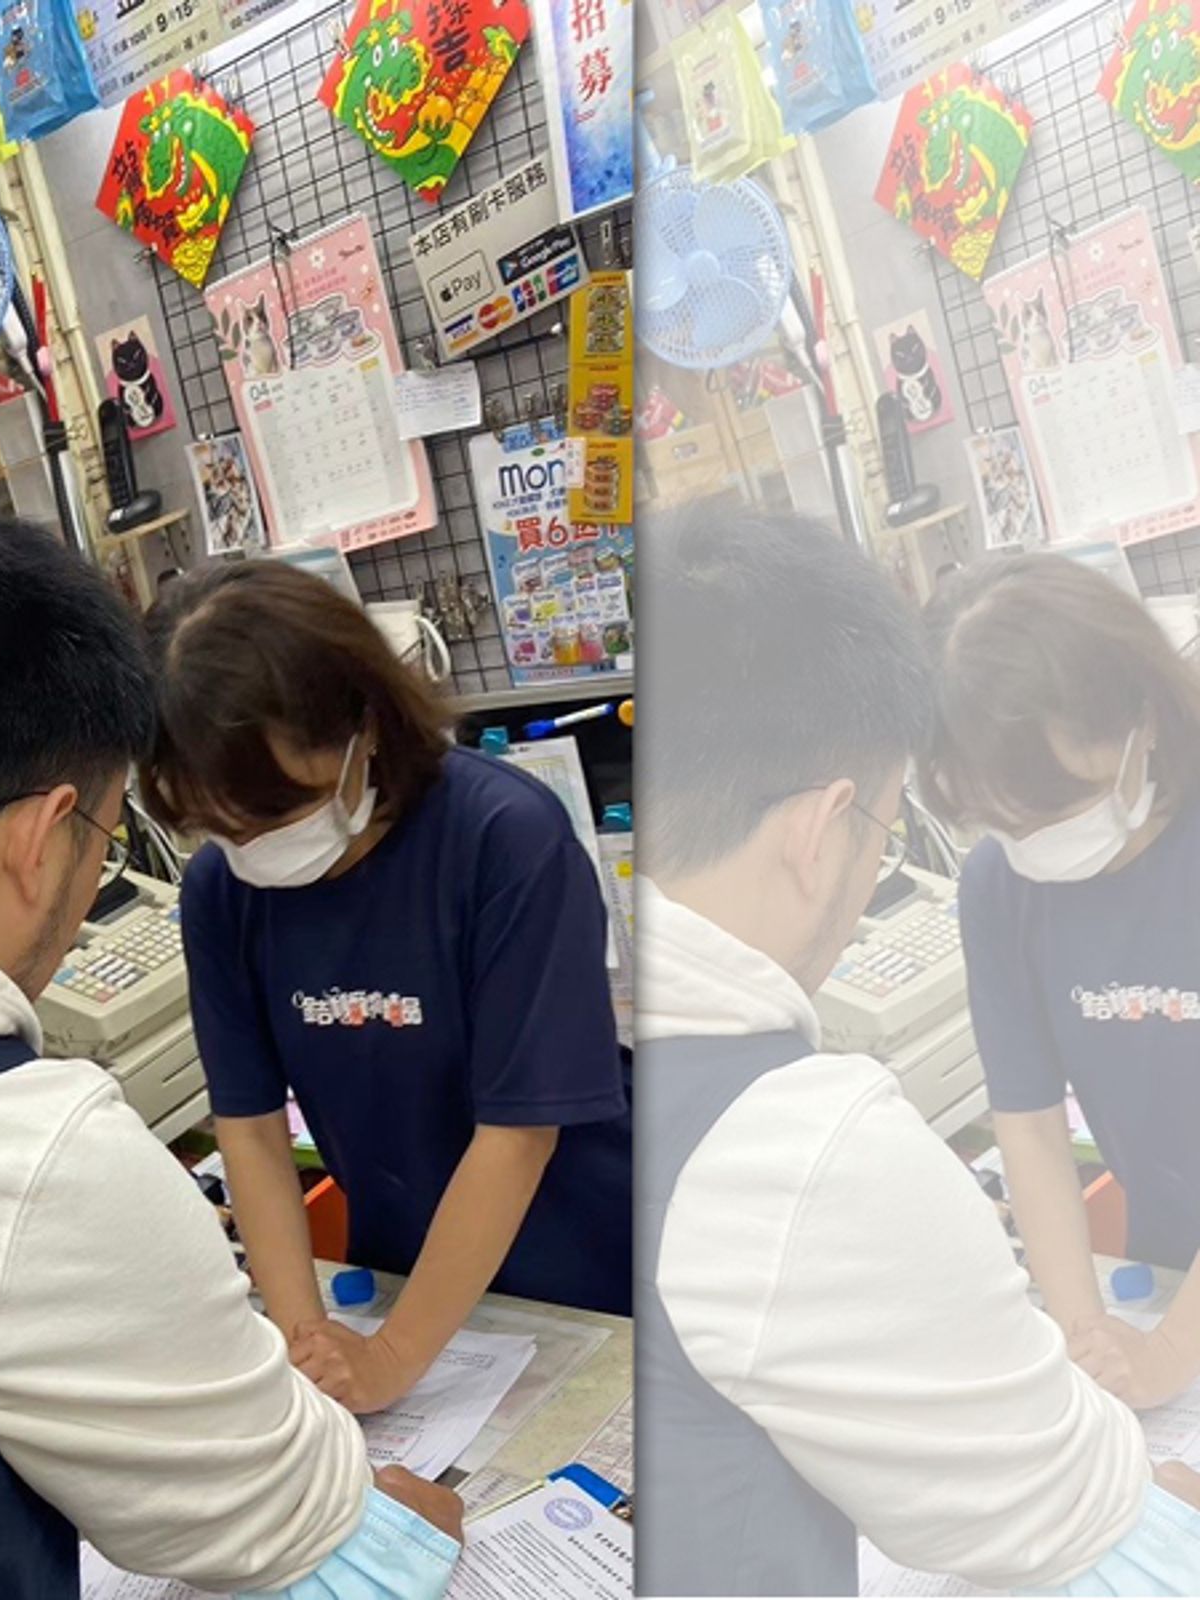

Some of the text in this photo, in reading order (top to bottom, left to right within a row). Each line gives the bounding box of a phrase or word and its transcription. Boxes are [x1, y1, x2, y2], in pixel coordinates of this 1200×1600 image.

[413, 162, 548, 257] 本店有刷卡服務
[451, 269, 482, 298] Pay
